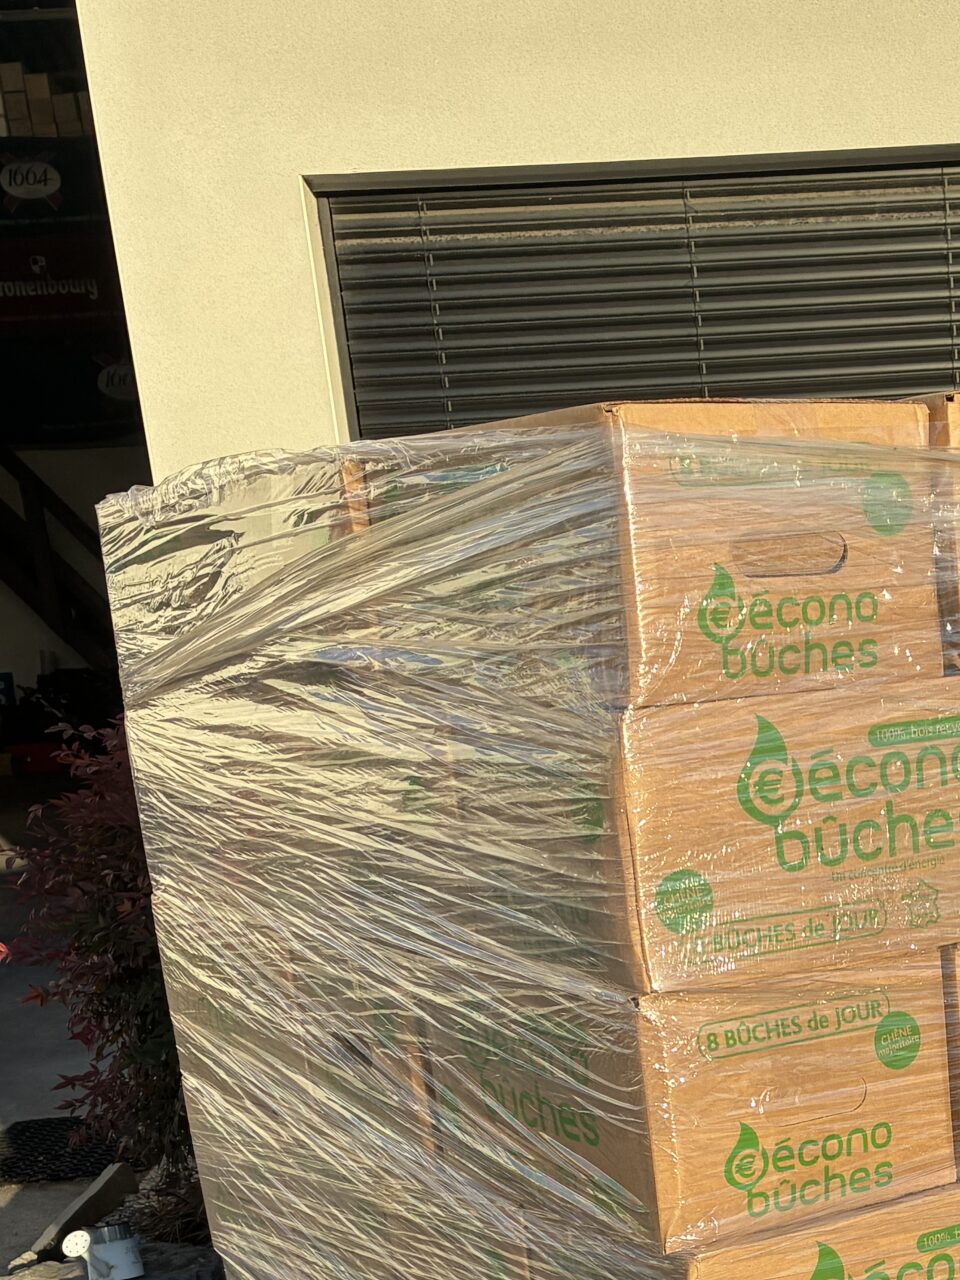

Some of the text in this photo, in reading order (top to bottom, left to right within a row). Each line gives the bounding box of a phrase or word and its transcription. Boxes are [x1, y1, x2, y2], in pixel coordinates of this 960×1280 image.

[8, 167, 52, 187] 1664
[0, 275, 98, 299] ronenbourg
[105, 369, 133, 388] 166
[750, 590, 878, 631] écono
[722, 636, 878, 679] bûches
[706, 1000, 883, 1051] 8 BÛCHES de JOUR
[880, 1024, 912, 1046] CHÊNE
[772, 1121, 892, 1173] écono
[747, 1160, 894, 1218] bûches
[924, 1232, 950, 1249] 100%
